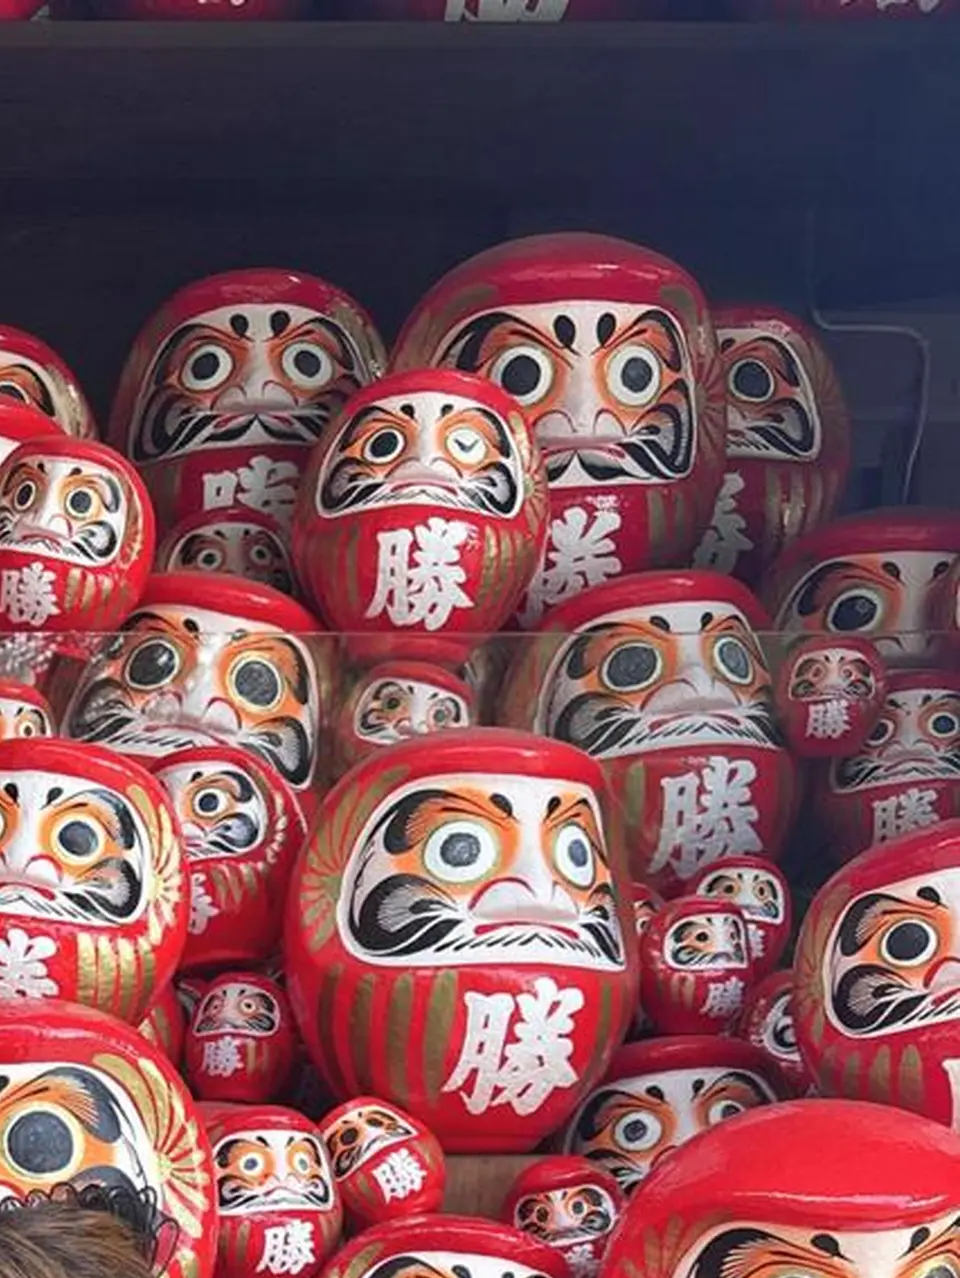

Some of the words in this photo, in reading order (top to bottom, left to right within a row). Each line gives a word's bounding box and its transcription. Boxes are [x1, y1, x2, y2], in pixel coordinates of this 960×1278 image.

[367, 517, 473, 630] 勝
[806, 700, 851, 738] 勝
[646, 755, 762, 879] 勝
[202, 1037, 242, 1077] 勝
[443, 977, 585, 1116] 勝
[373, 1147, 426, 1204] 勝
[257, 1219, 315, 1275] 勝
